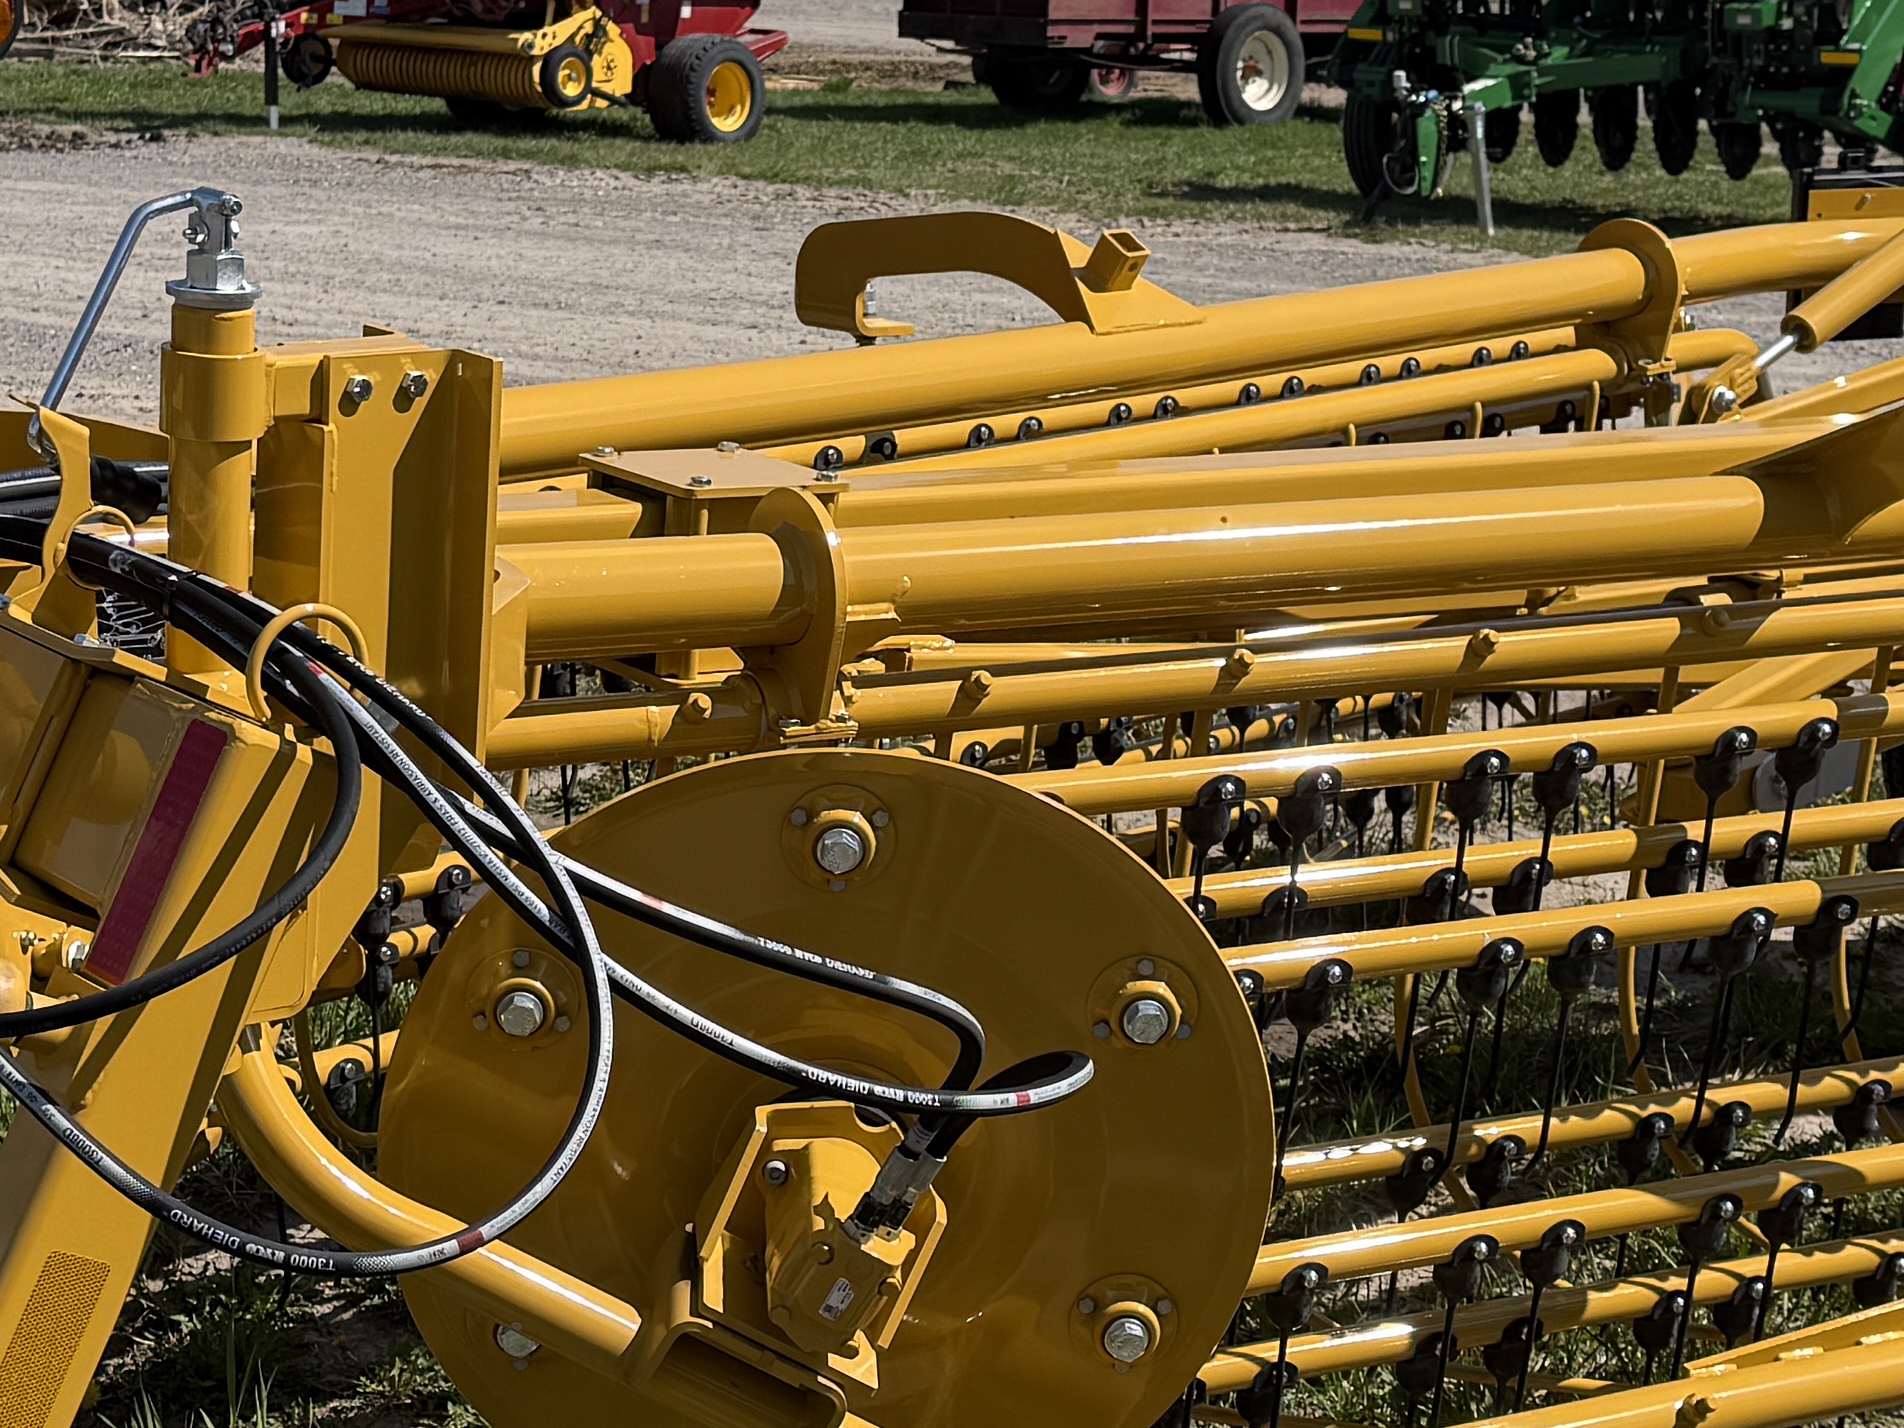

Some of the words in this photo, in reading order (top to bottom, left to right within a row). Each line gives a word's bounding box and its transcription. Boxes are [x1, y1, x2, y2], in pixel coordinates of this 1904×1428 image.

[802, 1069, 870, 1096] DIEHARD
[169, 1208, 241, 1248] DIEHARD
[290, 1254, 336, 1272] T3000
